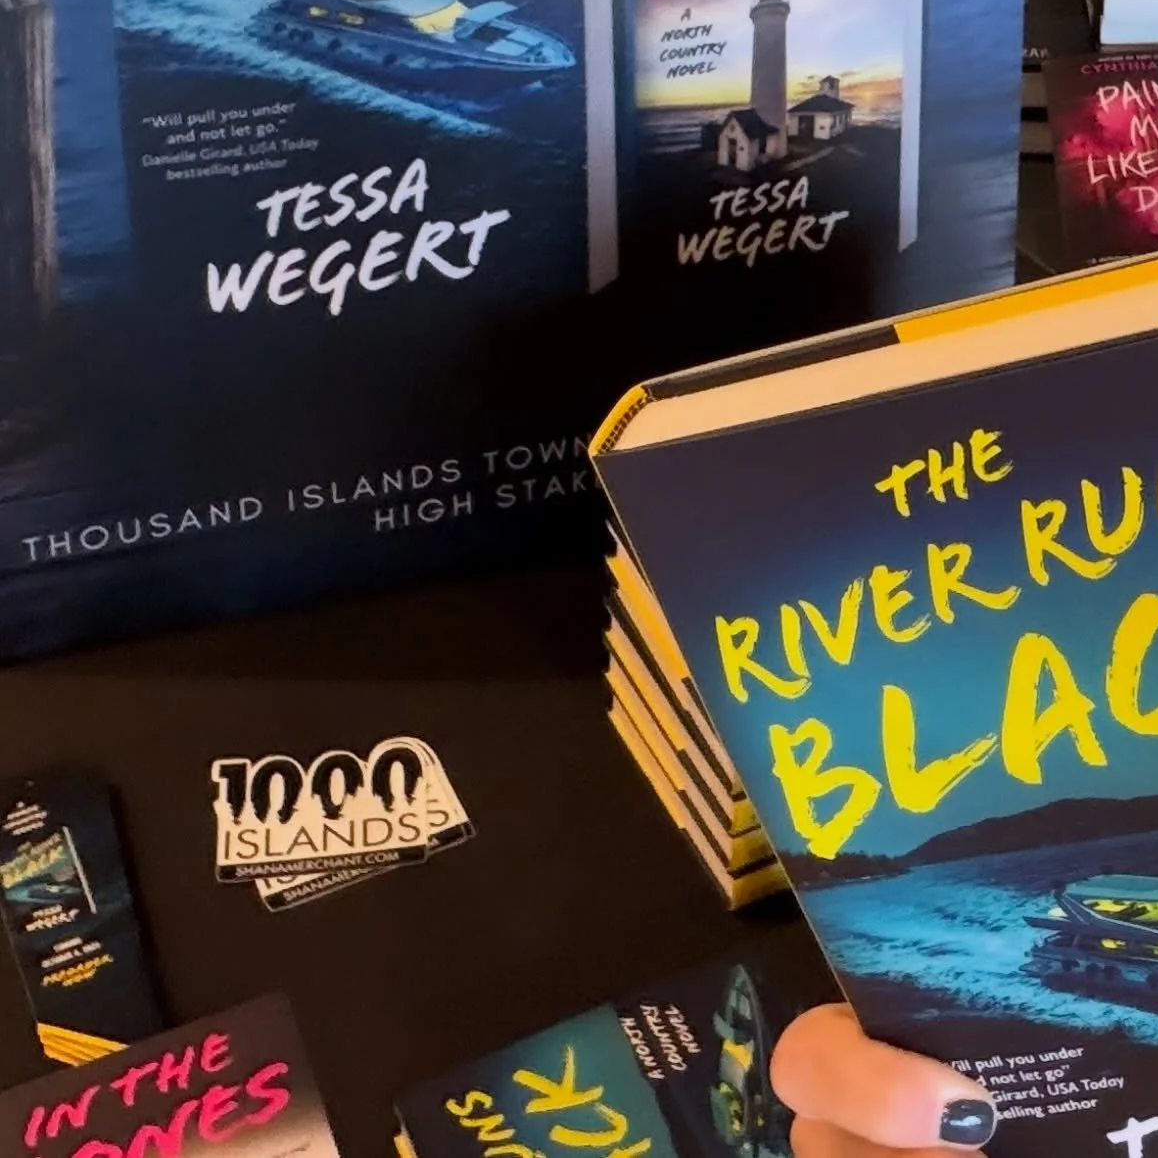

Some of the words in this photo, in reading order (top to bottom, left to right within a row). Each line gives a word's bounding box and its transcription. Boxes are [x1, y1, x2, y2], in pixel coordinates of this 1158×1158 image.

[661, 24, 713, 42] NORTH
[681, 8, 692, 21] A
[660, 42, 727, 63] COUNTRY
[667, 61, 717, 79] NOVEL
[1080, 60, 1158, 75] CYNTHIA
[167, 129, 195, 144] and
[200, 127, 226, 140] not
[231, 125, 252, 137] let
[187, 109, 216, 126] pull
[220, 108, 248, 123] you
[252, 102, 296, 117] under
[142, 149, 197, 167] Danielle
[281, 138, 319, 152] Today
[166, 162, 240, 180] bestselling
[243, 158, 288, 173] author
[256, 157, 430, 239] TESSA
[710, 176, 810, 221] TESSA
[677, 210, 849, 268] WEGERT
[207, 209, 511, 316] WEGERT
[874, 428, 1014, 518] THE
[22, 496, 263, 562] THOUSAND
[288, 458, 462, 511] ISLANDS
[374, 493, 474, 532] HIGH
[496, 469, 602, 509] STAK
[714, 540, 1022, 704] RIVER
[219, 746, 424, 826] 1000
[224, 812, 421, 860] ISLANDS
[619, 1017, 658, 1067] NORTH
[640, 1005, 687, 1071] COUNTRY
[664, 1005, 702, 1054] NOVEL
[974, 1055, 1004, 1073] pull
[1006, 1054, 1036, 1069] you
[1039, 1046, 1085, 1063] under
[990, 1072, 1018, 1086] not
[1020, 1070, 1043, 1083] let
[24, 1085, 101, 1147] IN
[110, 1032, 233, 1107] THE
[1047, 1081, 1079, 1097] USA
[1080, 1076, 1125, 1092] Today
[1047, 1097, 1099, 1114] author
